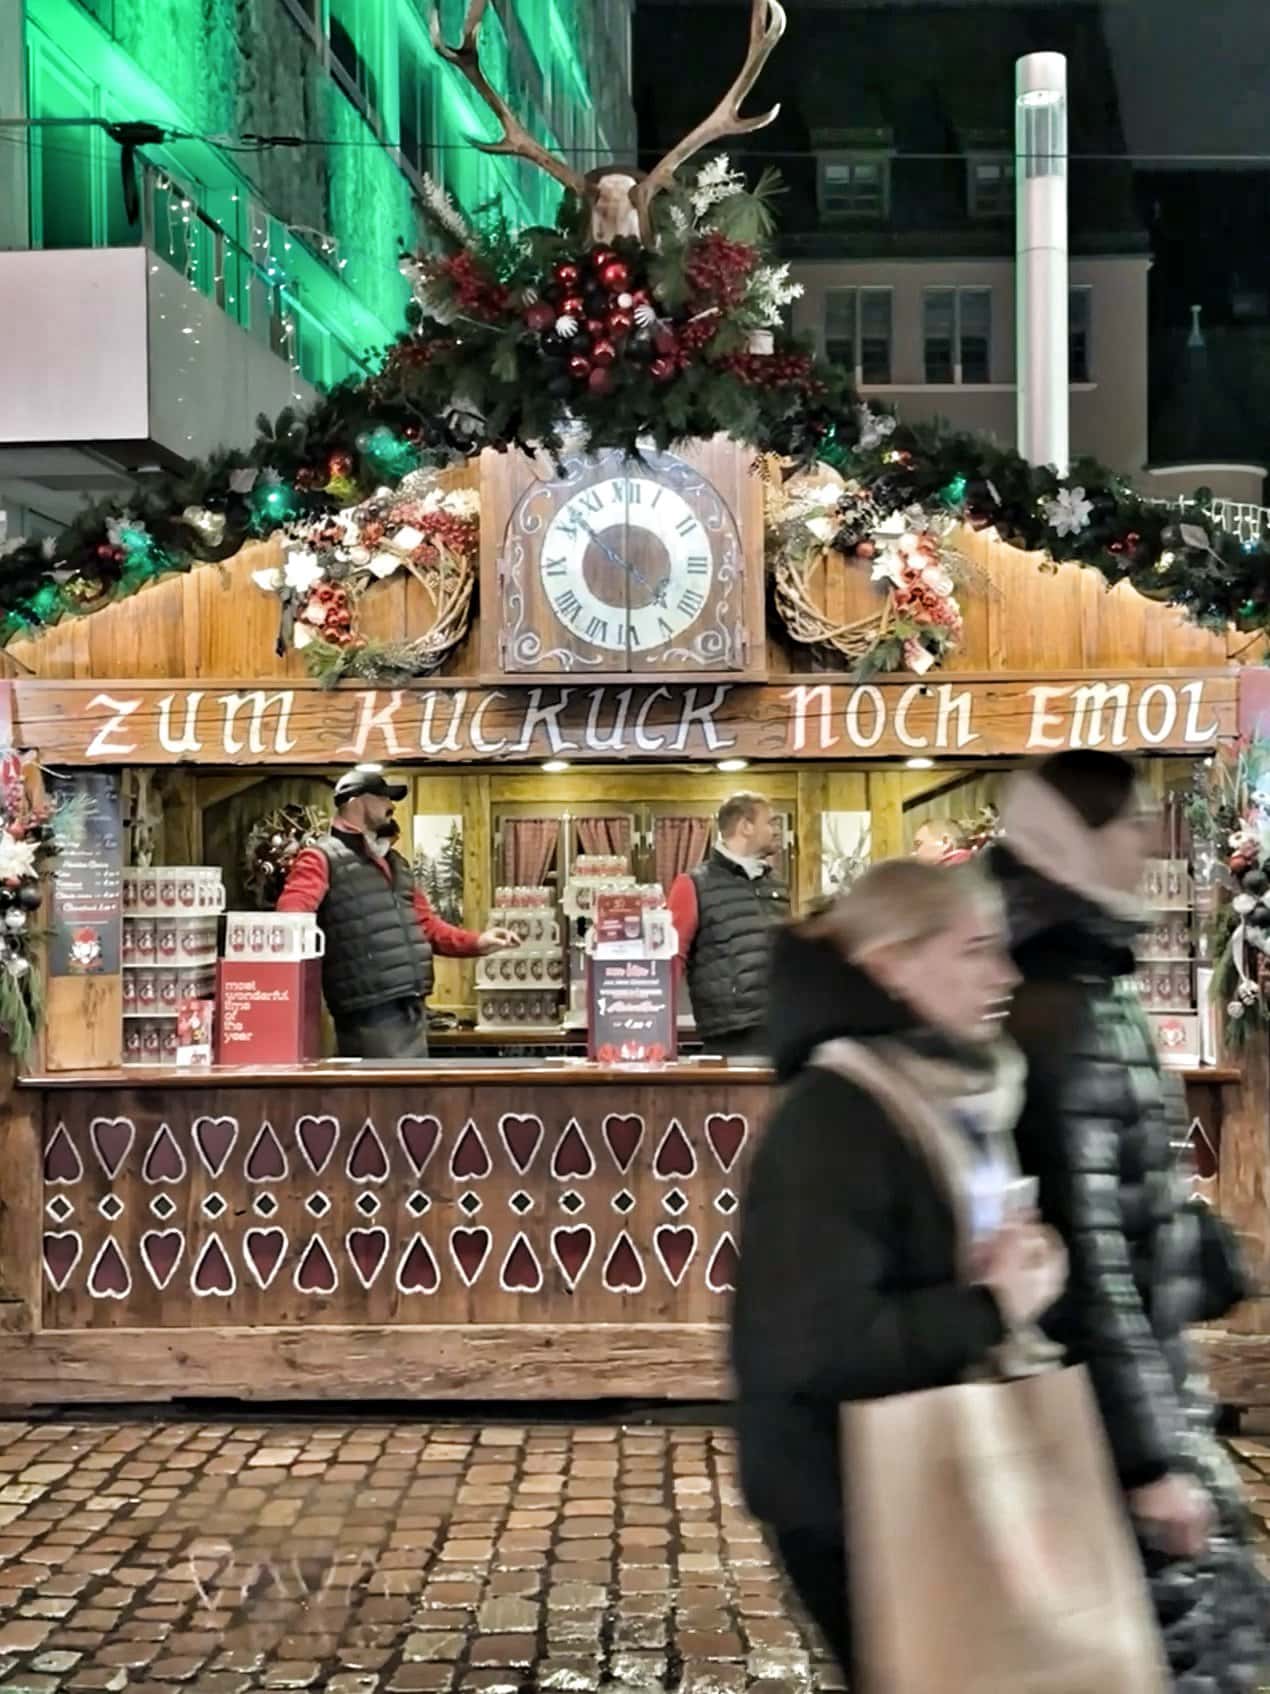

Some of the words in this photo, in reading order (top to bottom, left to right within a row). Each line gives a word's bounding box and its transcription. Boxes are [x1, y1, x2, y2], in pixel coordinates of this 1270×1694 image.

[611, 482, 641, 504] XII
[675, 515, 697, 537] II
[546, 556, 567, 576] IX
[687, 556, 708, 574] III
[584, 616, 608, 643] VII
[617, 624, 640, 646] VI
[656, 617, 674, 639] V
